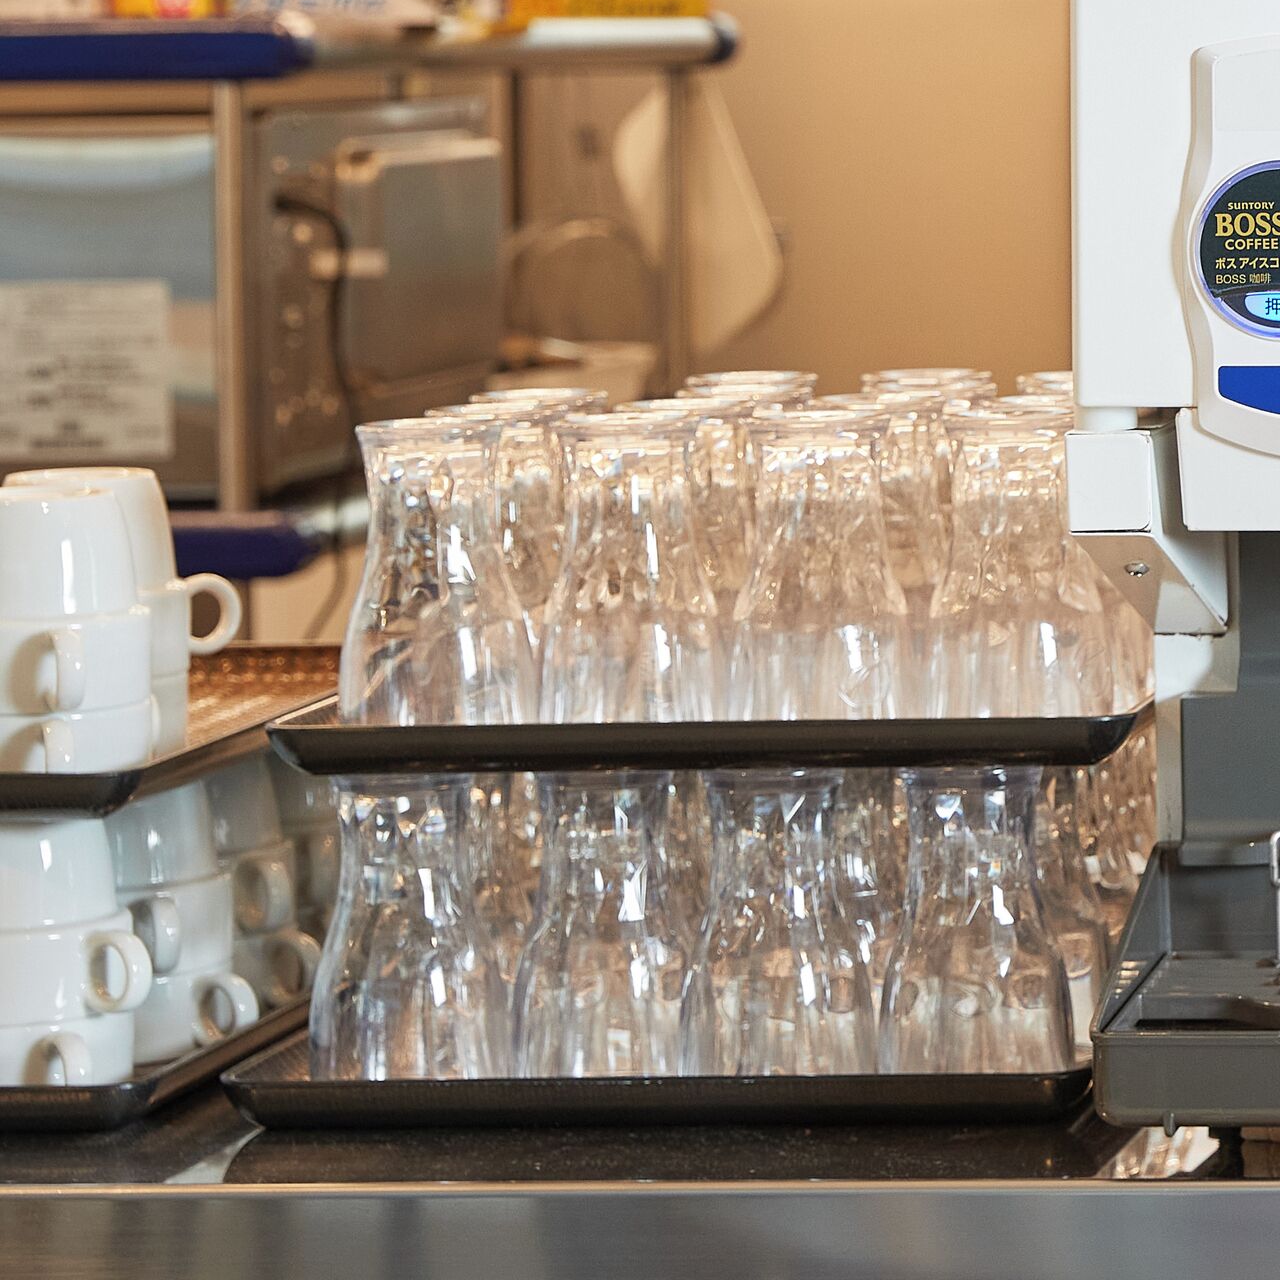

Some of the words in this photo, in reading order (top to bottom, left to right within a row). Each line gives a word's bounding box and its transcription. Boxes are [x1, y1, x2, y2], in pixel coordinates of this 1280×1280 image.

[1225, 238, 1279, 250] COFFEE
[1215, 257, 1237, 269] ボス
[1215, 274, 1247, 284] BOSS
